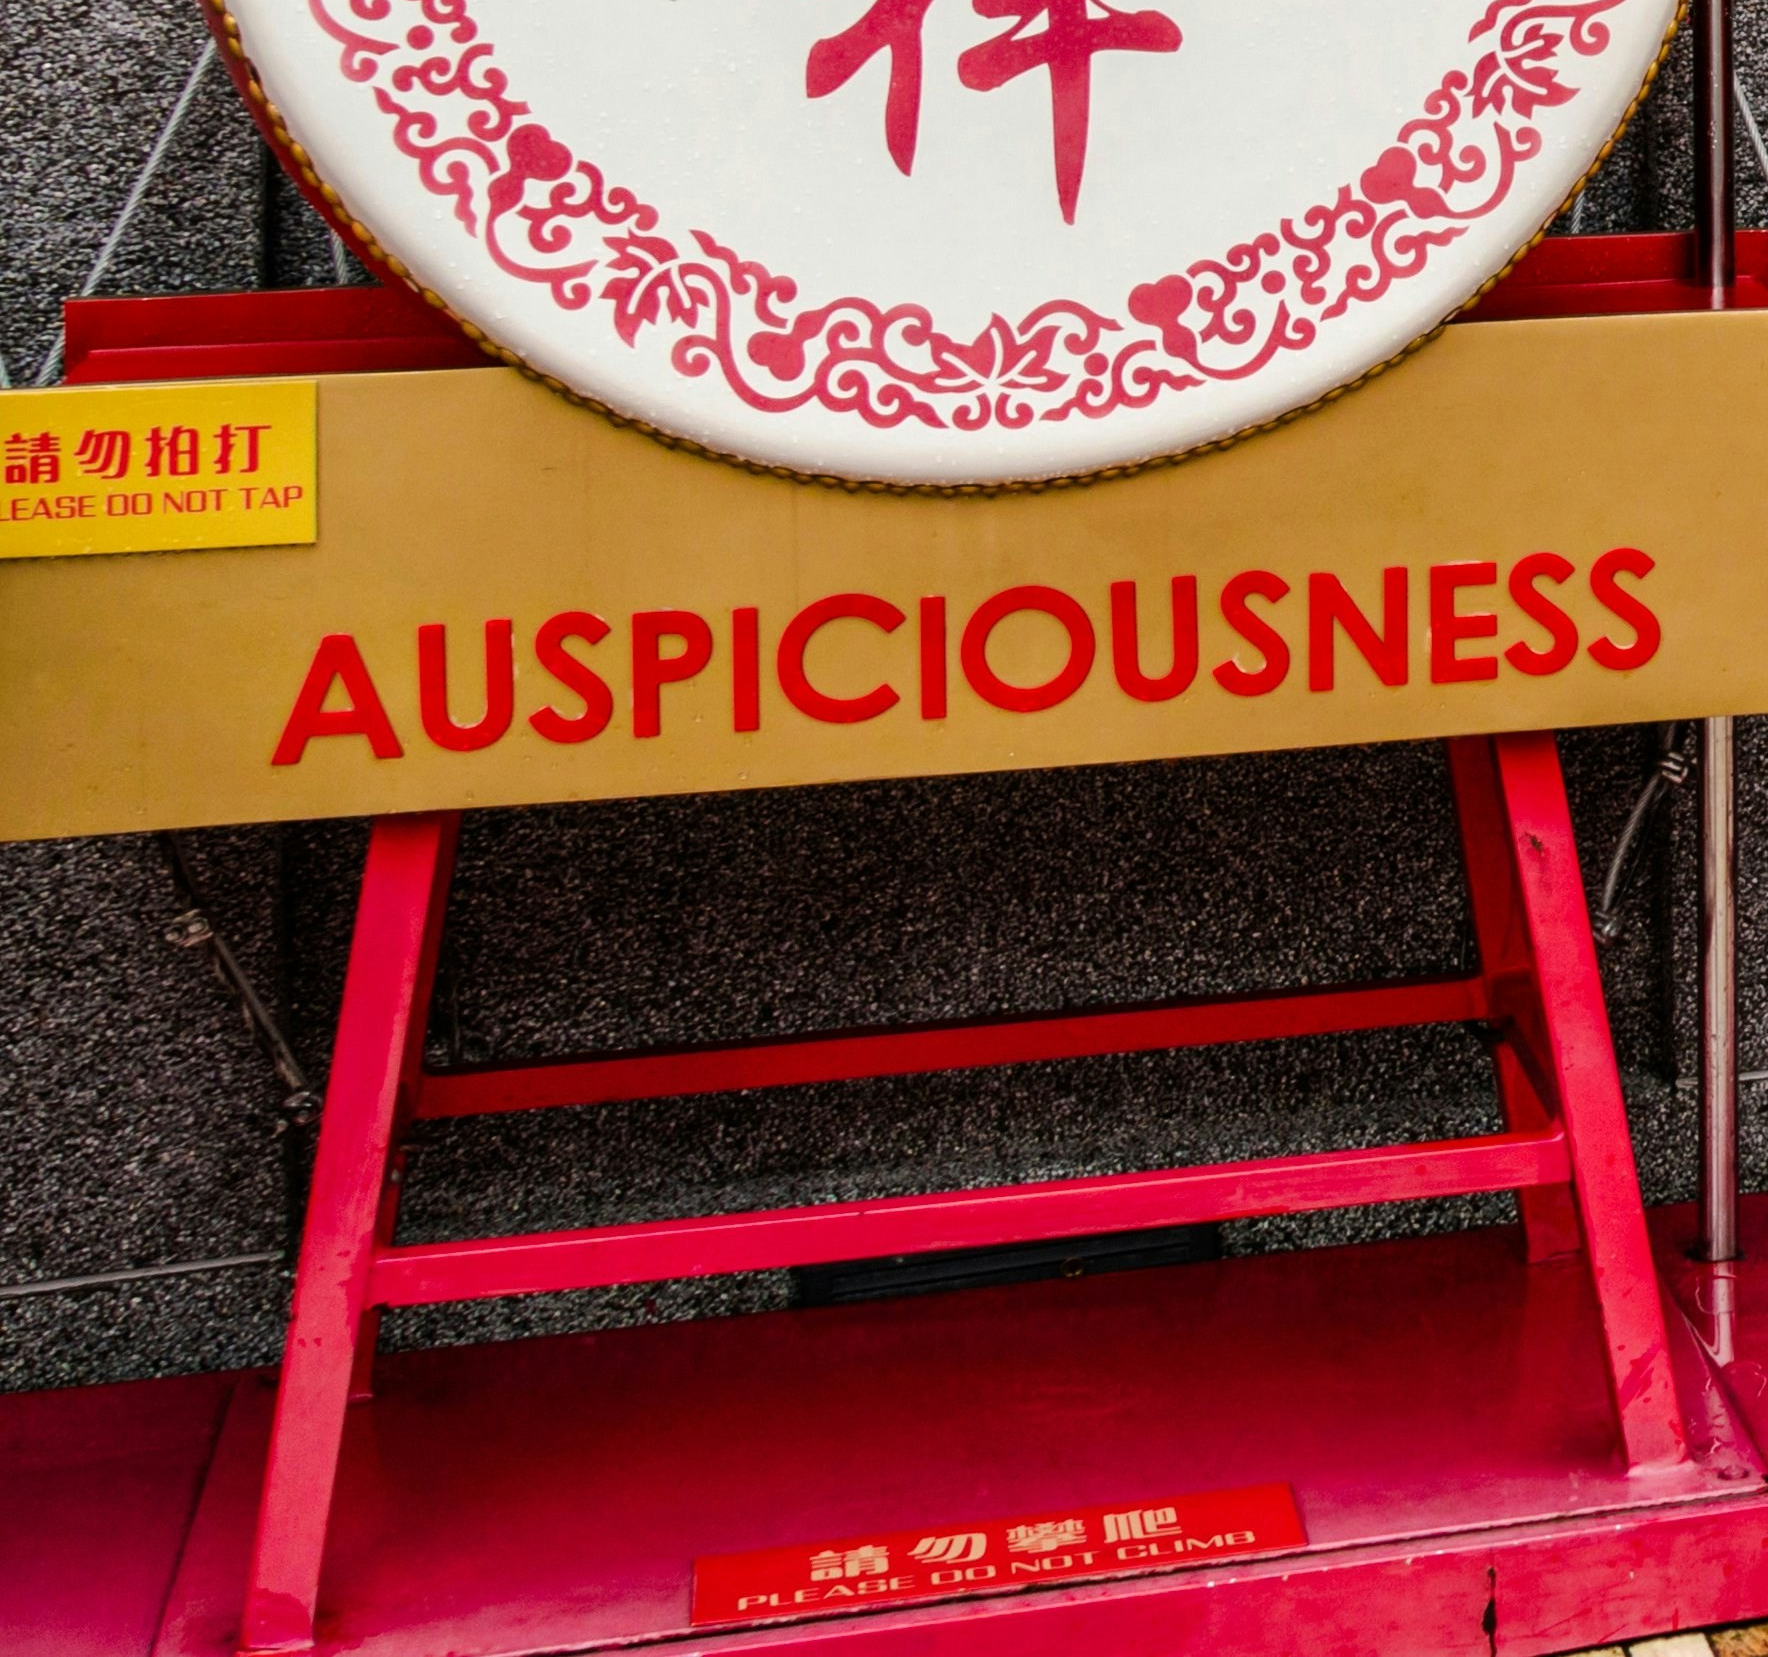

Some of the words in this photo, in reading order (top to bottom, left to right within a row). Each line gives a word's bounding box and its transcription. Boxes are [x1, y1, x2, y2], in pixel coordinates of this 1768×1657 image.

[5, 423, 272, 484] 請勿拍打
[106, 492, 153, 517] DO
[162, 489, 229, 514] NOT
[239, 485, 304, 510] TAP
[271, 547, 1663, 767] AUSPICIOUSNESS
[737, 1574, 916, 1611] PLEASE
[930, 1565, 997, 1585] DO
[1011, 1550, 1100, 1575] NOT
[1116, 1530, 1256, 1561] CLIMB
[809, 1506, 1183, 1582] 請勿攀爬
